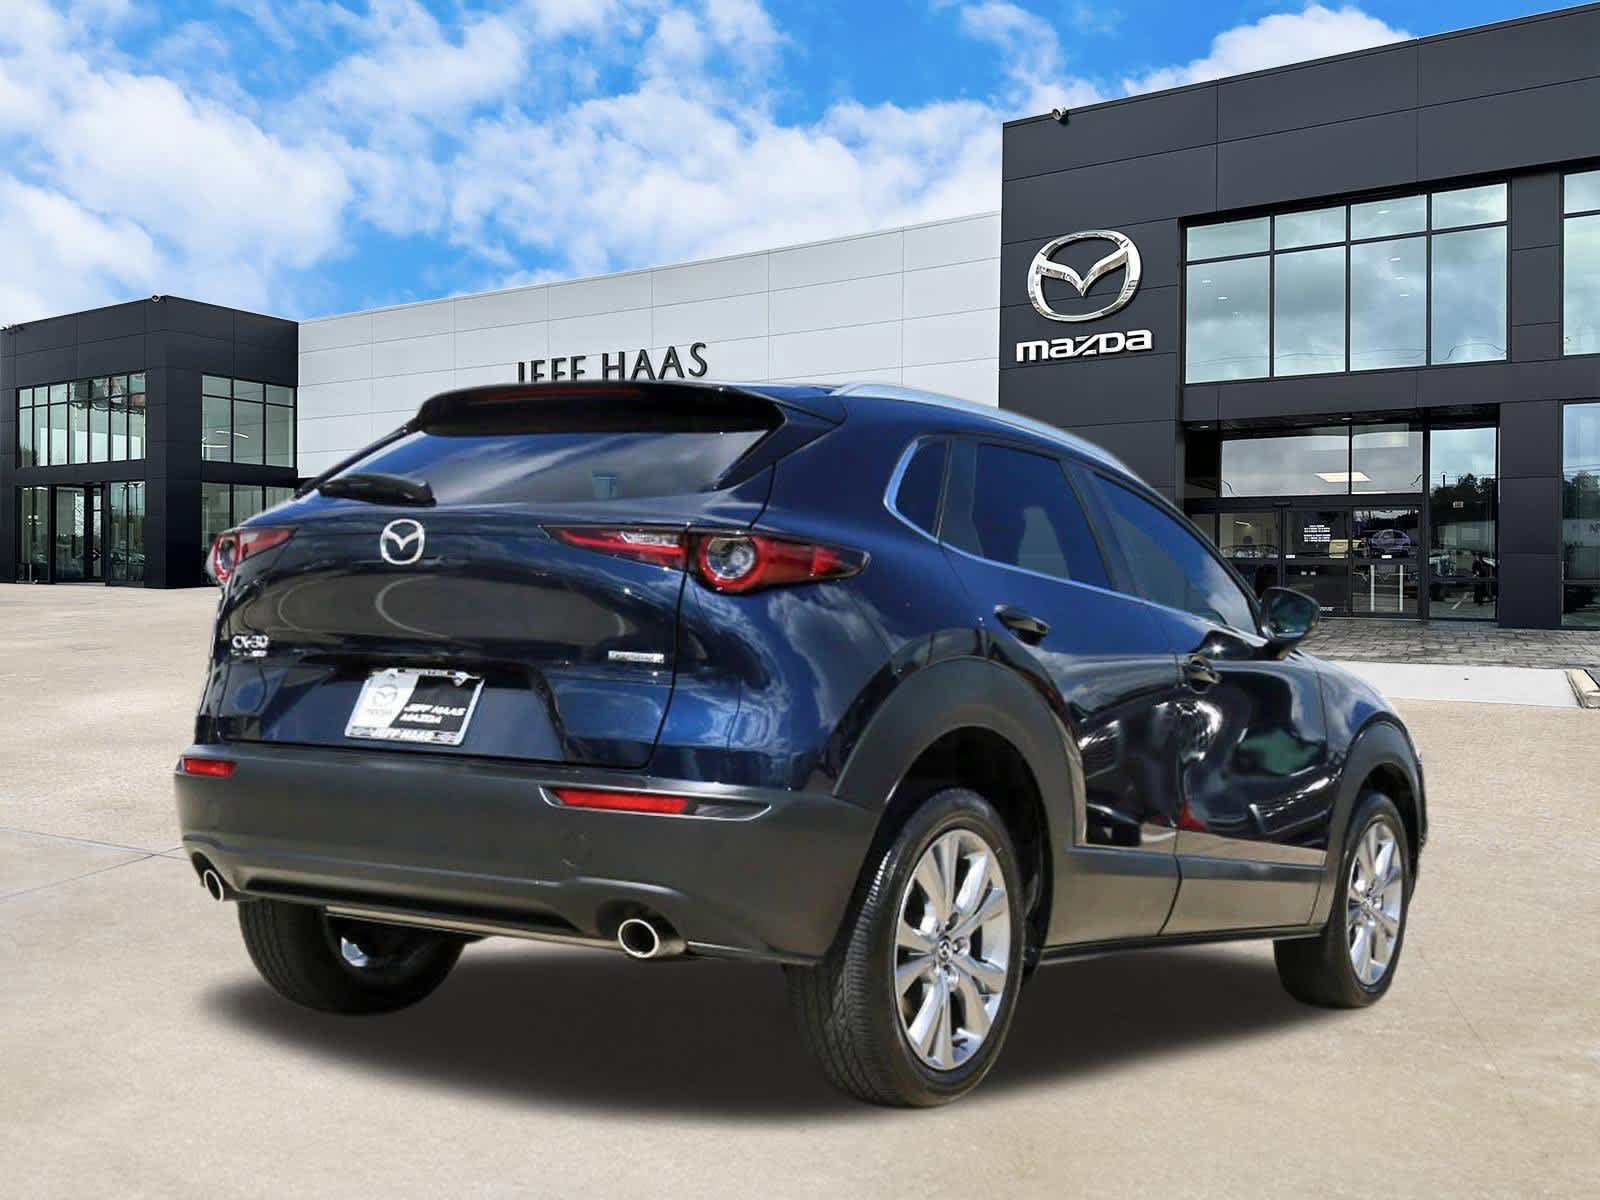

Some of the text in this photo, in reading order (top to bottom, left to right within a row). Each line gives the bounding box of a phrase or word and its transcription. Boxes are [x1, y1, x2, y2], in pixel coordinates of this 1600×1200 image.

[601, 342, 708, 381] HAAS
[1016, 329, 1152, 362] mazda
[430, 705, 466, 717] HAAS
